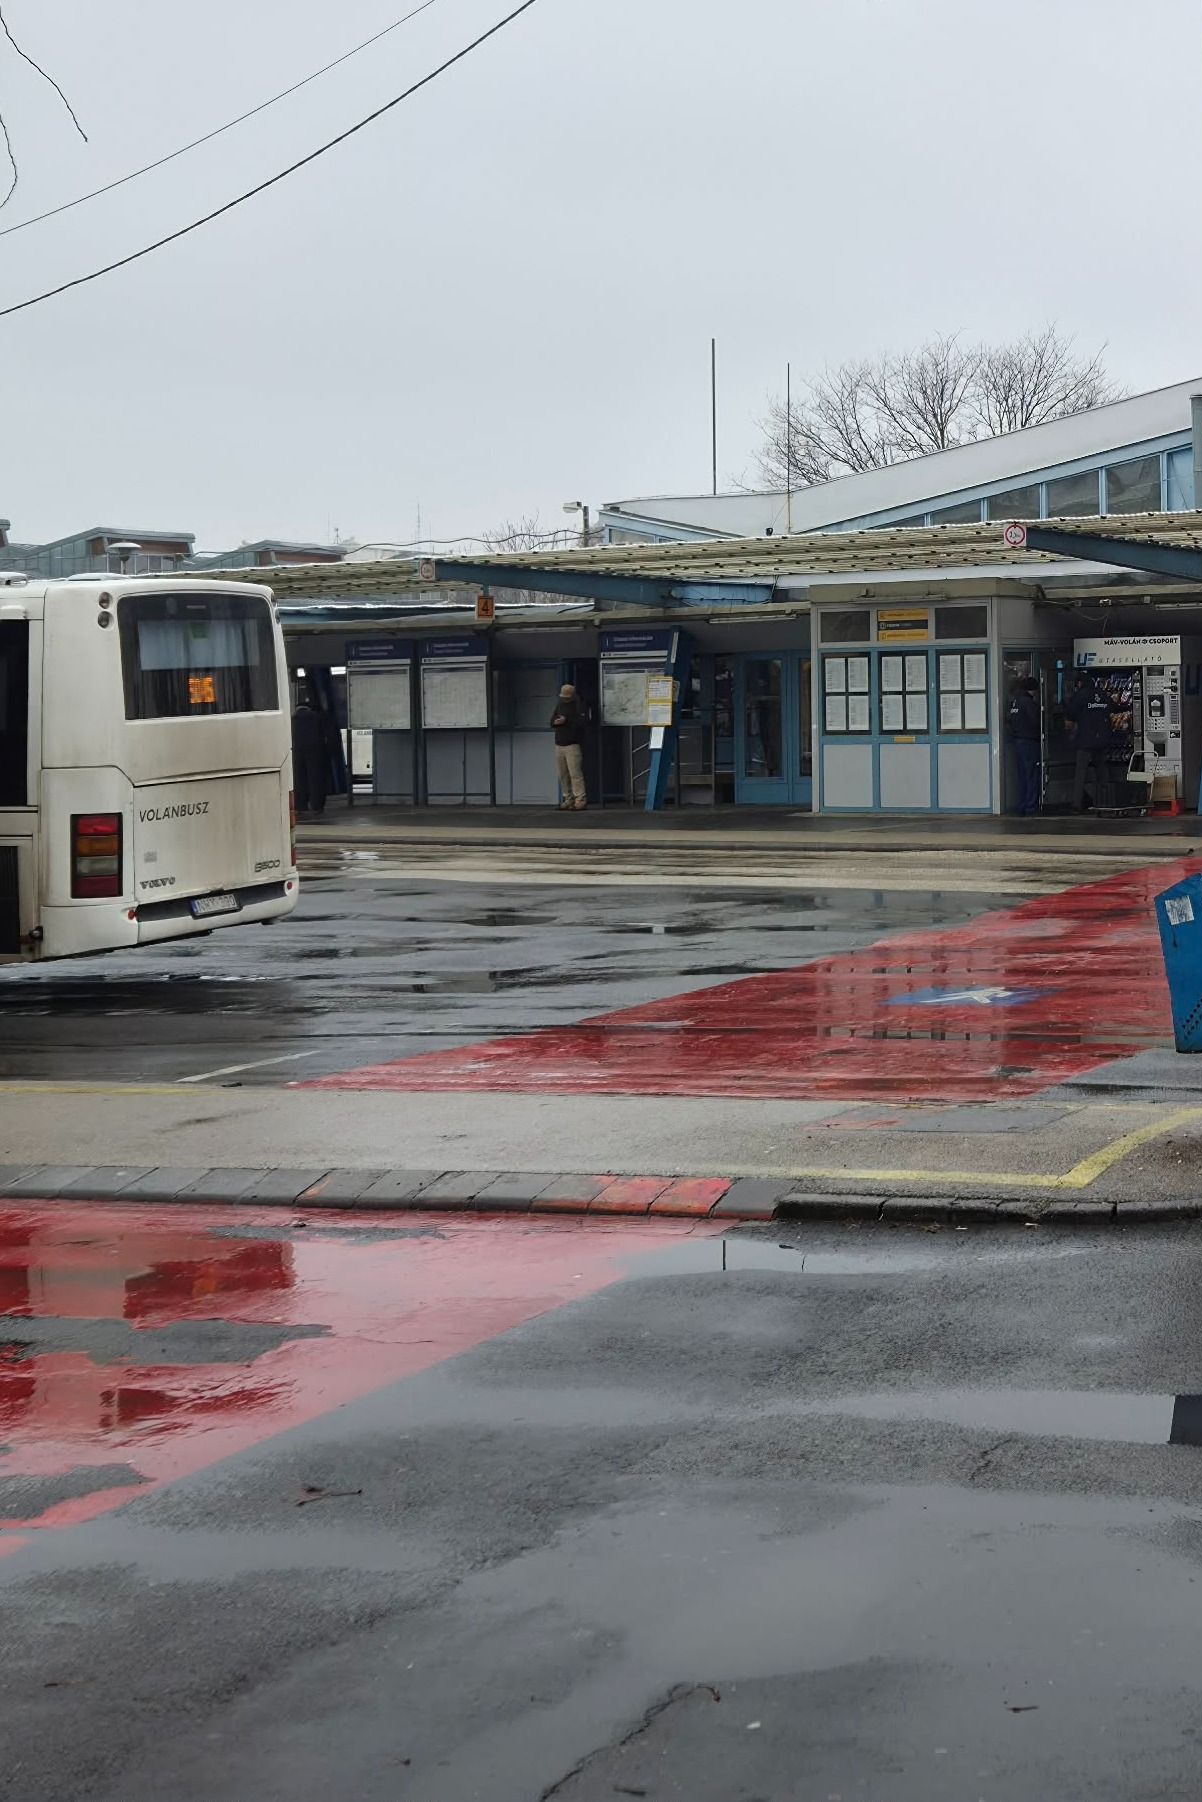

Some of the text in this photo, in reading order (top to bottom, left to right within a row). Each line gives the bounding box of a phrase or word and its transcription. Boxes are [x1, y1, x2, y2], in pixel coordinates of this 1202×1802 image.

[482, 599, 491, 615] 4
[140, 801, 209, 823] VOLÁNBUSZ
[140, 876, 176, 890] VOLVO
